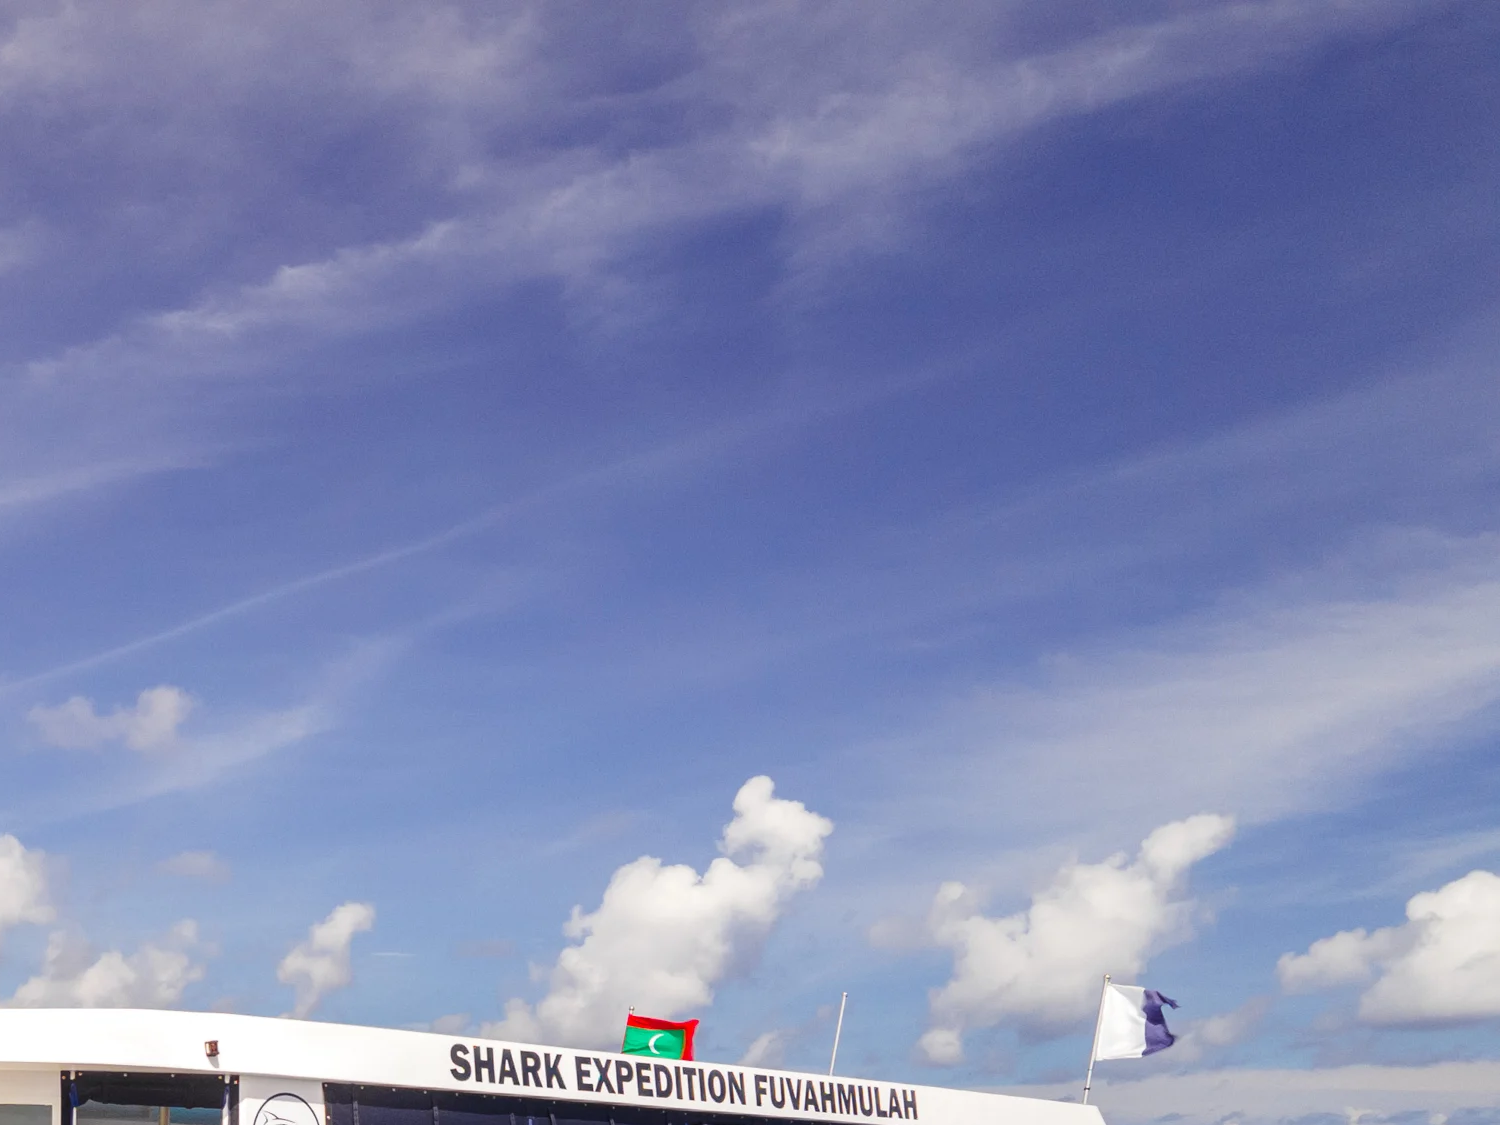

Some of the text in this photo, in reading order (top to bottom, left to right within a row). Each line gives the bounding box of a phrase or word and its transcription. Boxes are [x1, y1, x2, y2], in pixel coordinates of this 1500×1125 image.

[450, 1043, 919, 1120] SHARK EXPEDITION FUVAHMULAH
